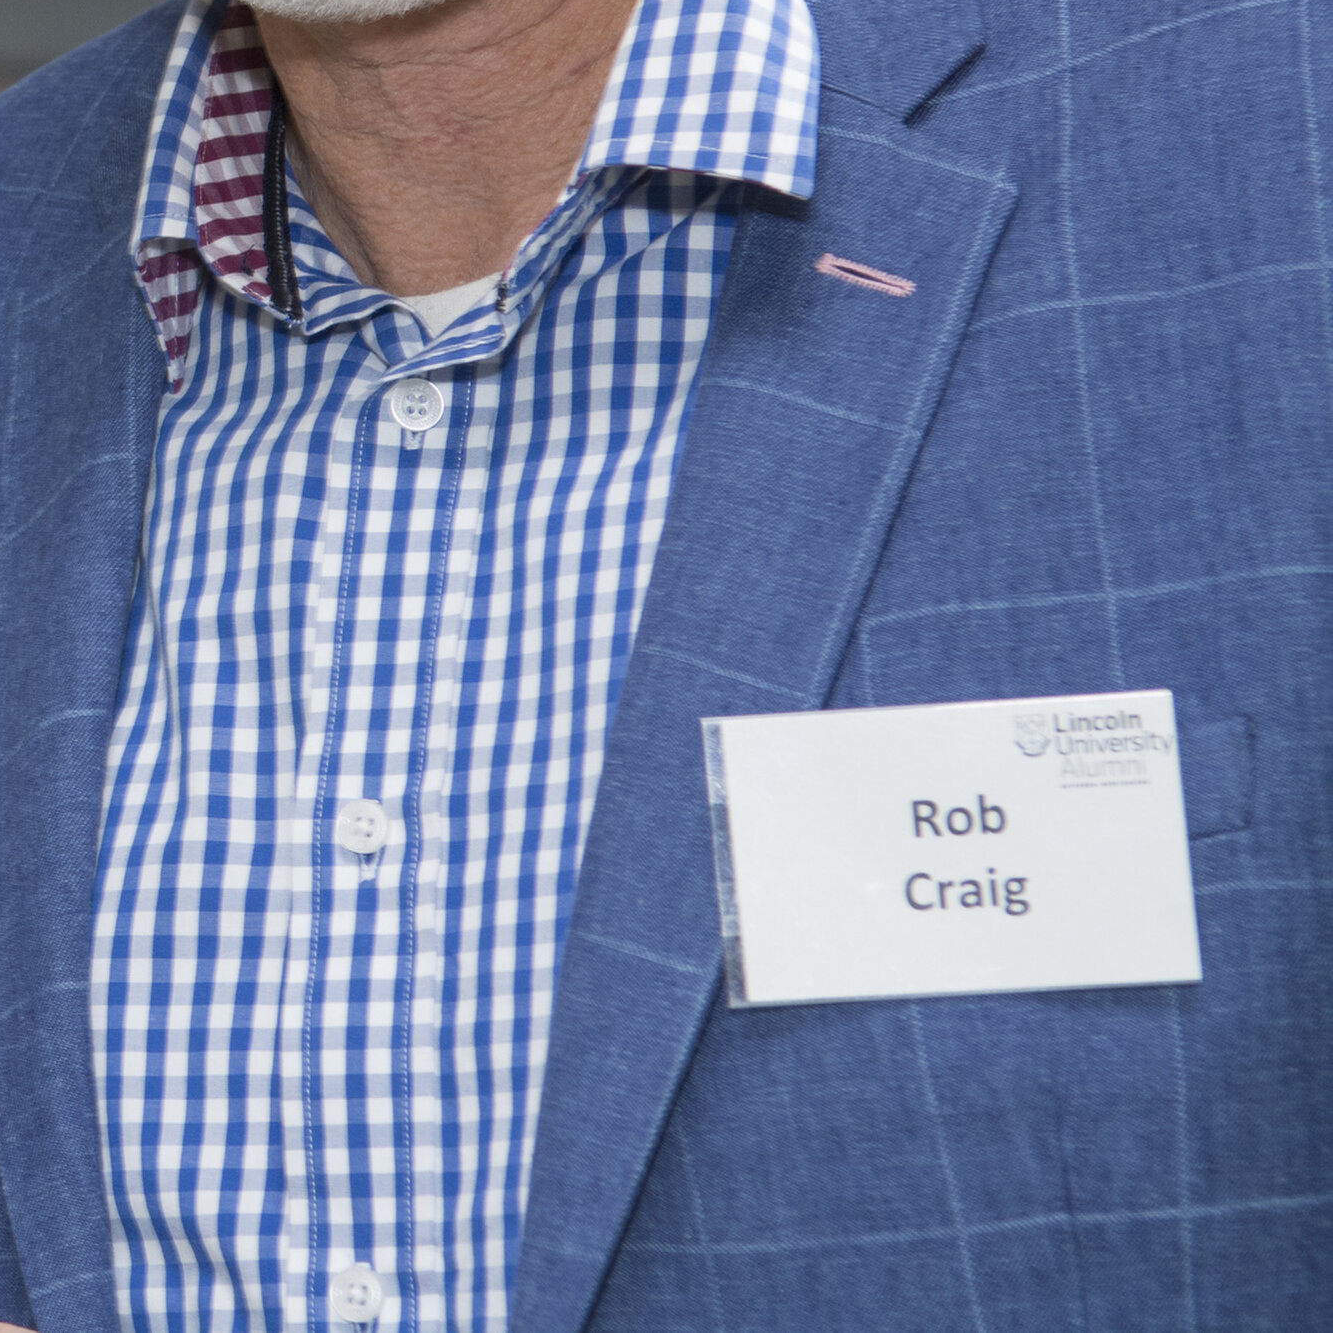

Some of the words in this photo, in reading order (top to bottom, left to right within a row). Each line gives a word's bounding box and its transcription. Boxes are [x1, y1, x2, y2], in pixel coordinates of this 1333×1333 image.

[1053, 709, 1142, 733] Lincoln
[1055, 729, 1174, 755] University
[911, 794, 1007, 838] Rob
[904, 867, 1031, 916] Craig
